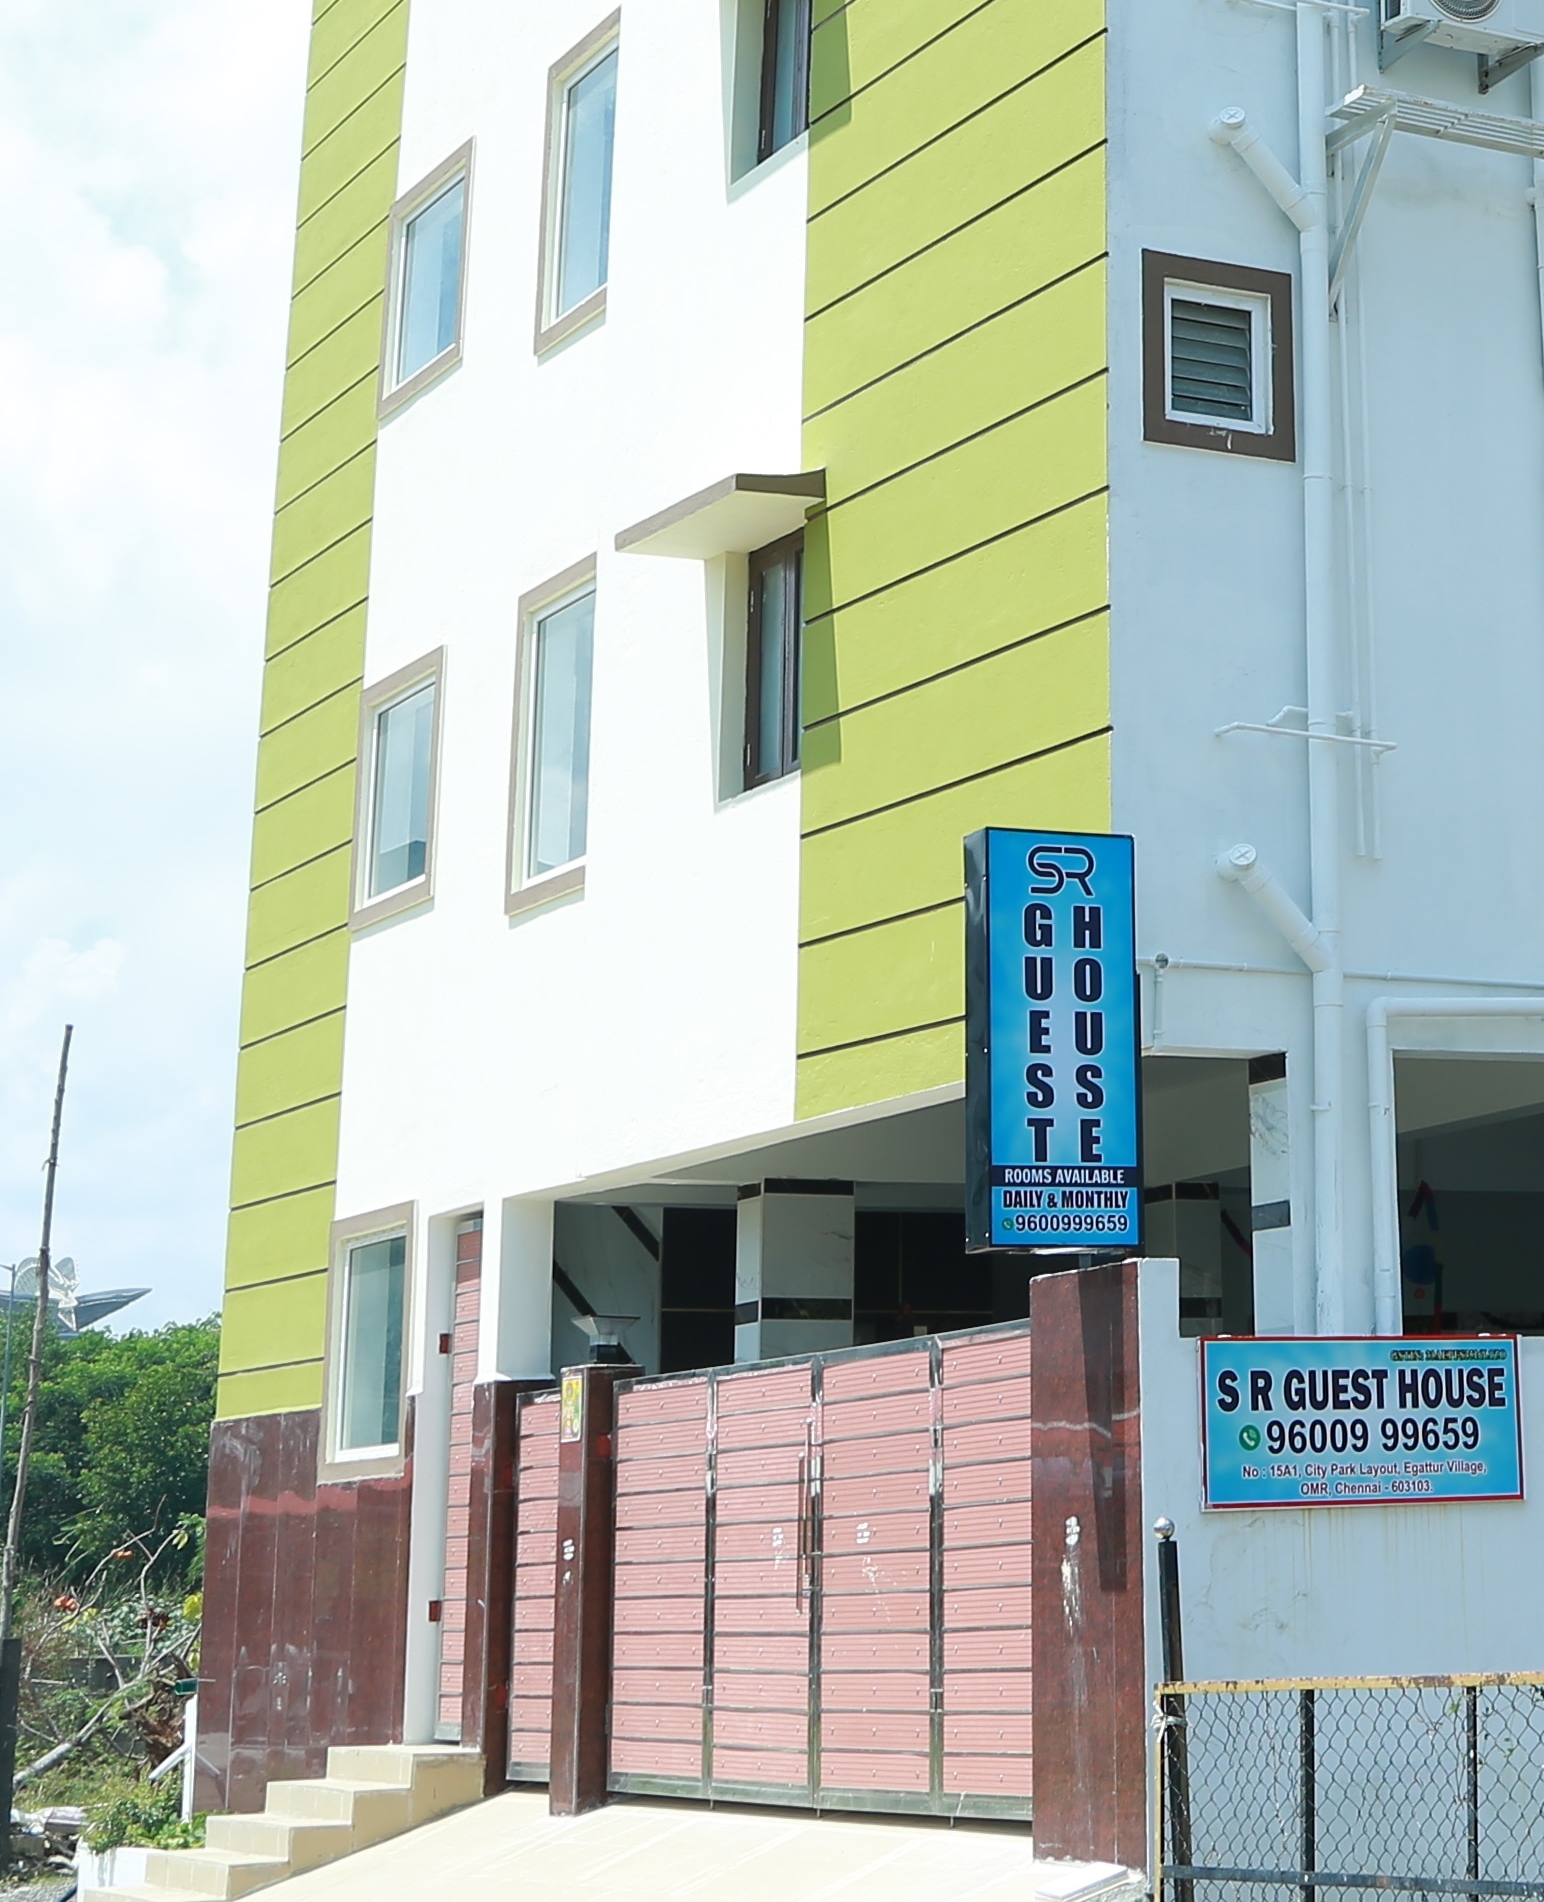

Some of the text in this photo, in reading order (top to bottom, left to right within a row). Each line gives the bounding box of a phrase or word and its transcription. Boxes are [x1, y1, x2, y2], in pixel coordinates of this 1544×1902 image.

[1029, 845, 1095, 896] SR
[1024, 903, 1055, 1163] GUEST
[1073, 905, 1104, 1163] HOUSE
[1005, 1168, 1125, 1184] ROOMS AVAILABLE
[1003, 1190, 1128, 1209] DAILY & MONTHLY
[1015, 1214, 1128, 1232] 9600999659
[1217, 1367, 1506, 1412] S R GUEST HOUSE
[1266, 1416, 1479, 1454] 96009 99659
[1242, 1465, 1259, 1478] No
[1270, 1464, 1302, 1479] 15A1,
[1304, 1463, 1327, 1479] City
[1331, 1463, 1356, 1476] Park
[1360, 1462, 1400, 1477] Layout,
[1404, 1461, 1444, 1476] Egattur
[1447, 1460, 1487, 1475] Village,
[1300, 1482, 1332, 1497] OMR,
[1335, 1481, 1381, 1494] Chennai
[1391, 1479, 1433, 1493] 603103.
